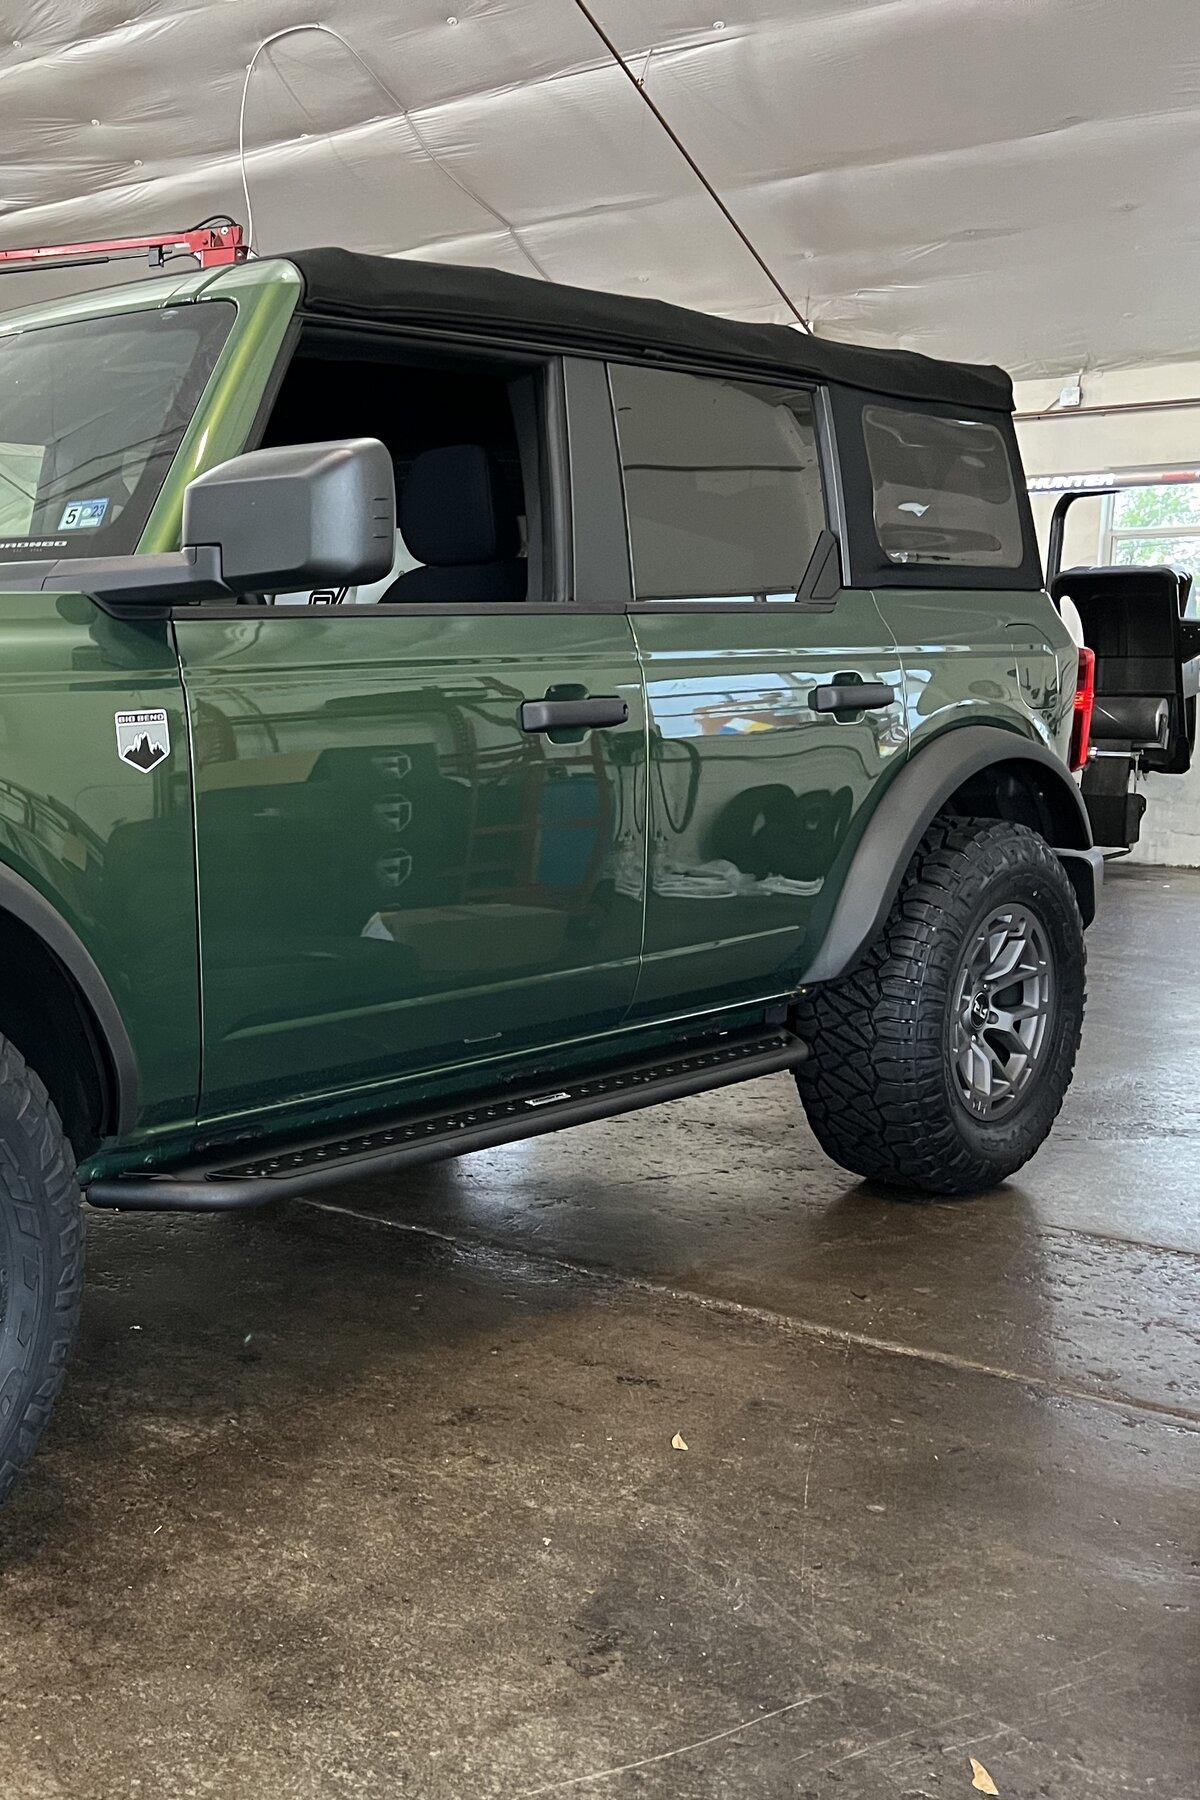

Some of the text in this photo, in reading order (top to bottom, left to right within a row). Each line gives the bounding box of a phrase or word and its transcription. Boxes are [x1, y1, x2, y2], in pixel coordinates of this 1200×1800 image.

[1027, 473, 1115, 490] HUNTER
[65, 504, 105, 525] 5 23
[117, 712, 165, 724] BIG BEND
